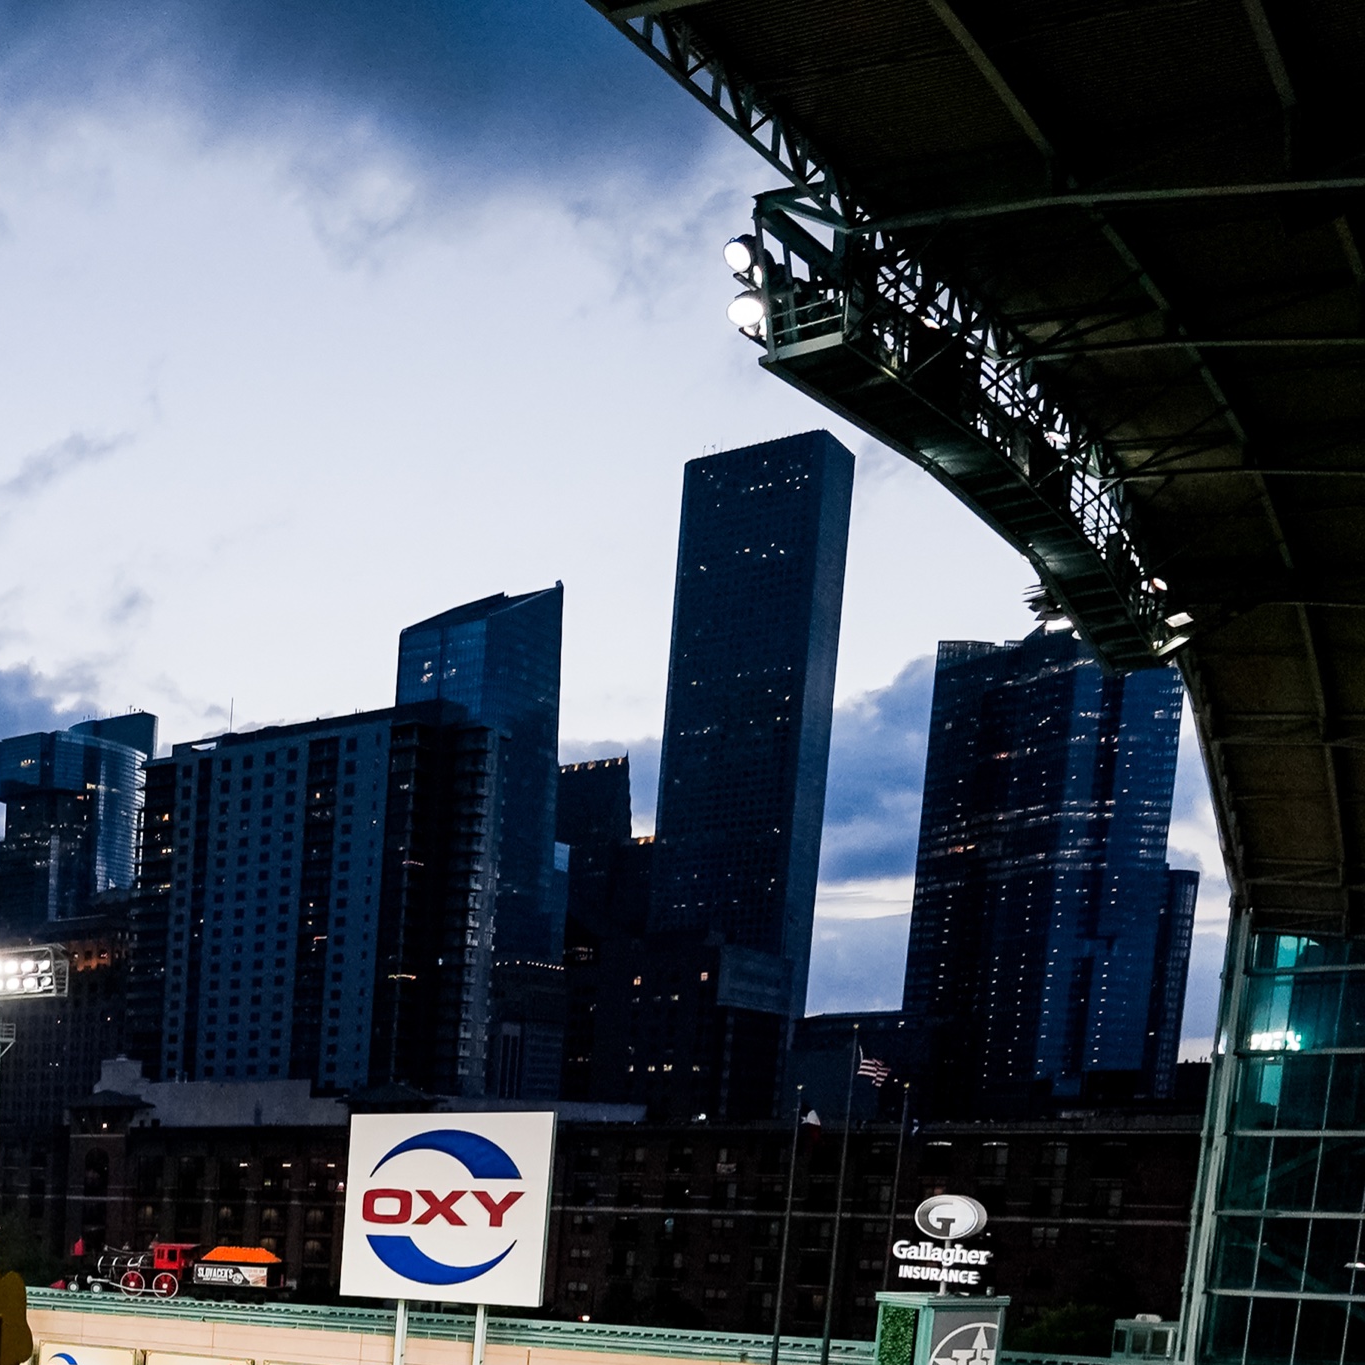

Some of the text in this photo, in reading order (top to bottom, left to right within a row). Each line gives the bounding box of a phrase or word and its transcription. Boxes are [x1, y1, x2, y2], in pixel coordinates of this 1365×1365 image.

[362, 1188, 526, 1227] OXY
[892, 1240, 991, 1266] Gallagher
[898, 1264, 980, 1285] INSURANCE
